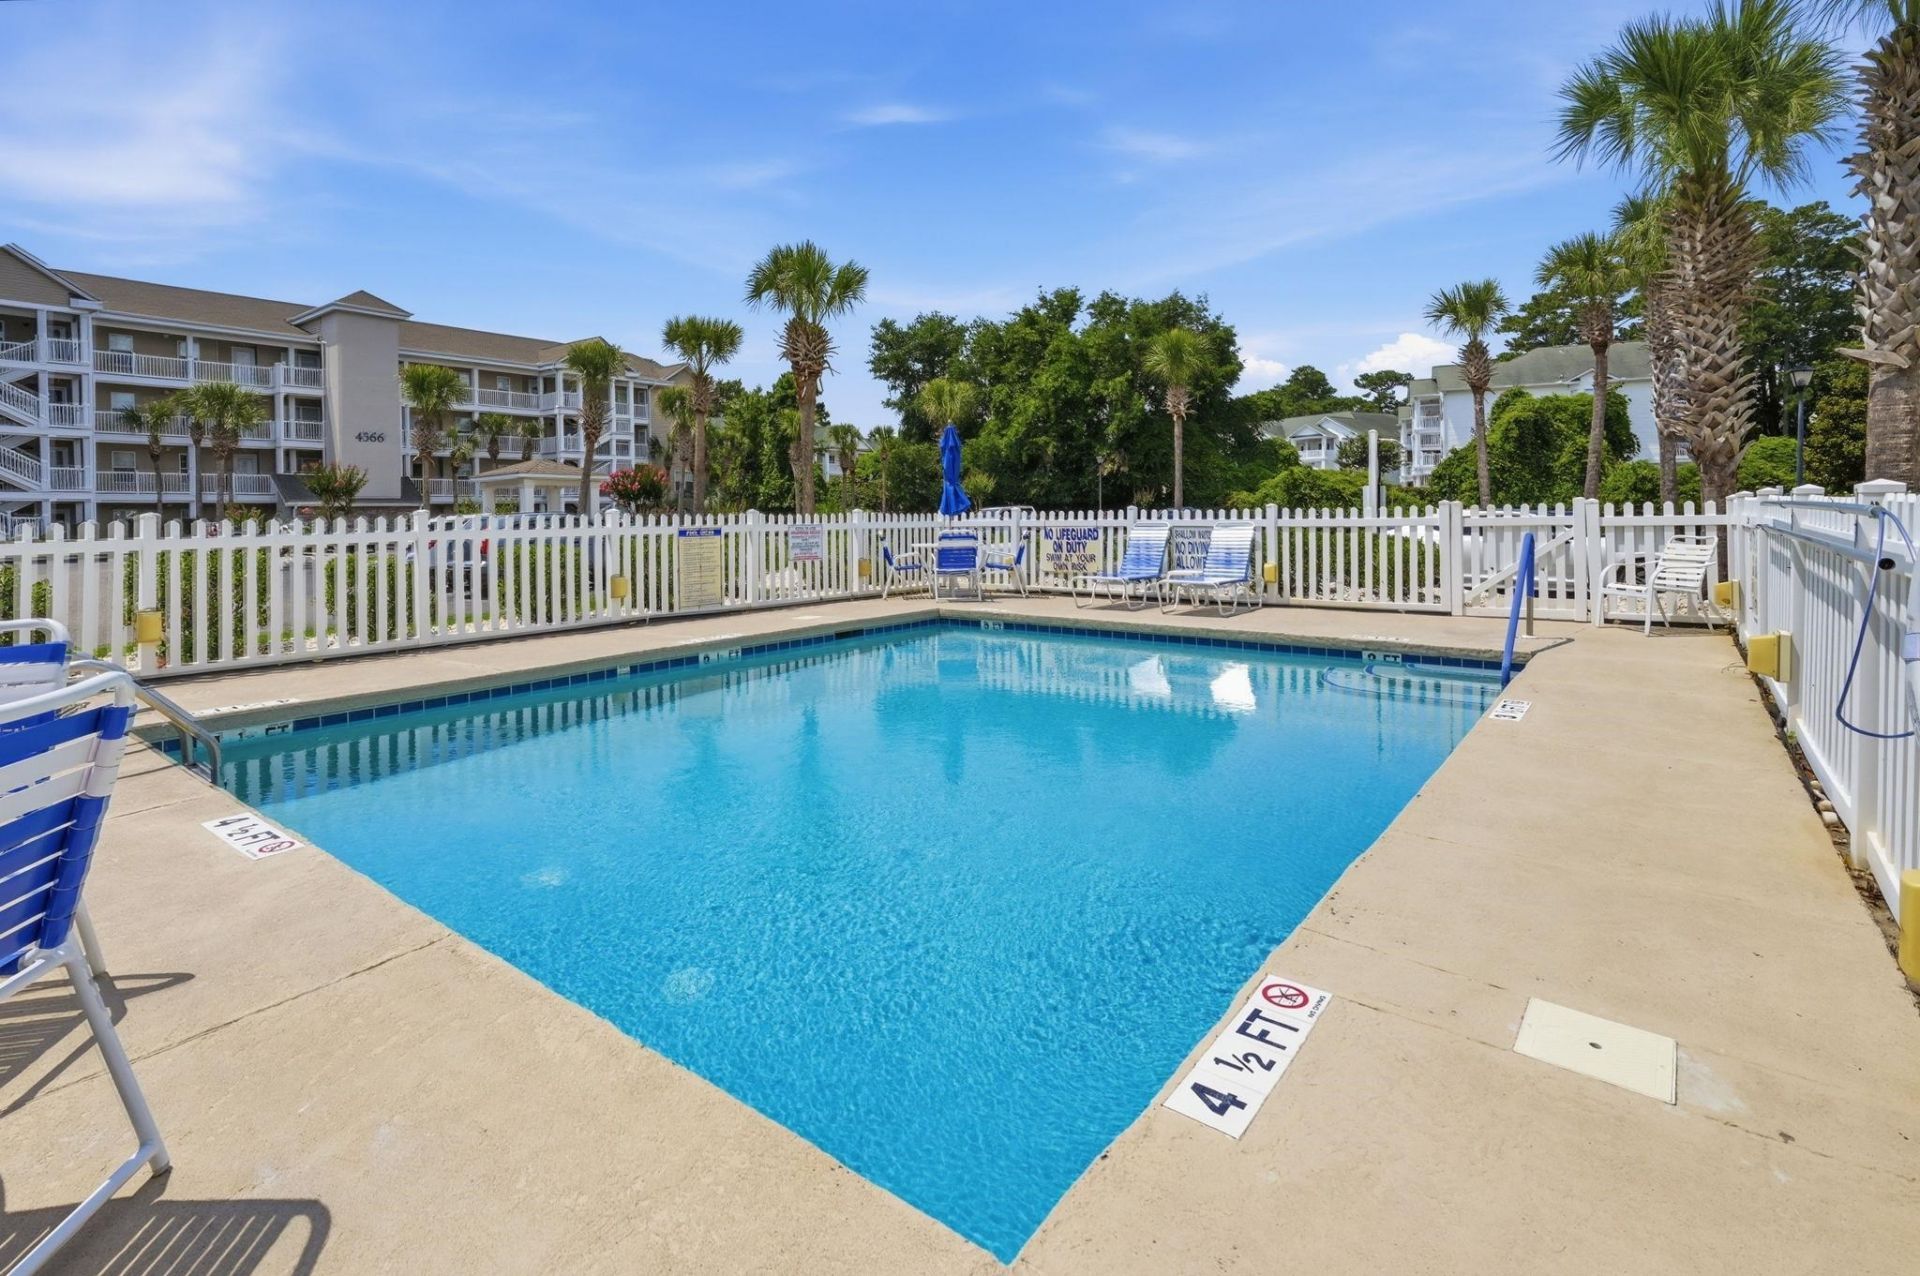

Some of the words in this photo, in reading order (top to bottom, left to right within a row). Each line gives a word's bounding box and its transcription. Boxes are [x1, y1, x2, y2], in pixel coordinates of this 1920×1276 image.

[355, 431, 385, 443] 4566
[1044, 527, 1053, 540] NO
[1055, 527, 1099, 541] LIFEGUARD
[1053, 540, 1063, 553] ON
[1066, 540, 1087, 553] DUTY
[1175, 541, 1186, 555] NO
[1188, 541, 1209, 555] DIVIN
[1046, 553, 1062, 562] SWIM
[1064, 553, 1073, 562] AT
[1076, 553, 1096, 563] YOUR
[1176, 555, 1207, 569] ALLOWE
[213, 817, 250, 828] 4
[234, 830, 281, 846] FT
[1190, 1082, 1248, 1117] 4
[1235, 1008, 1300, 1051] FT
